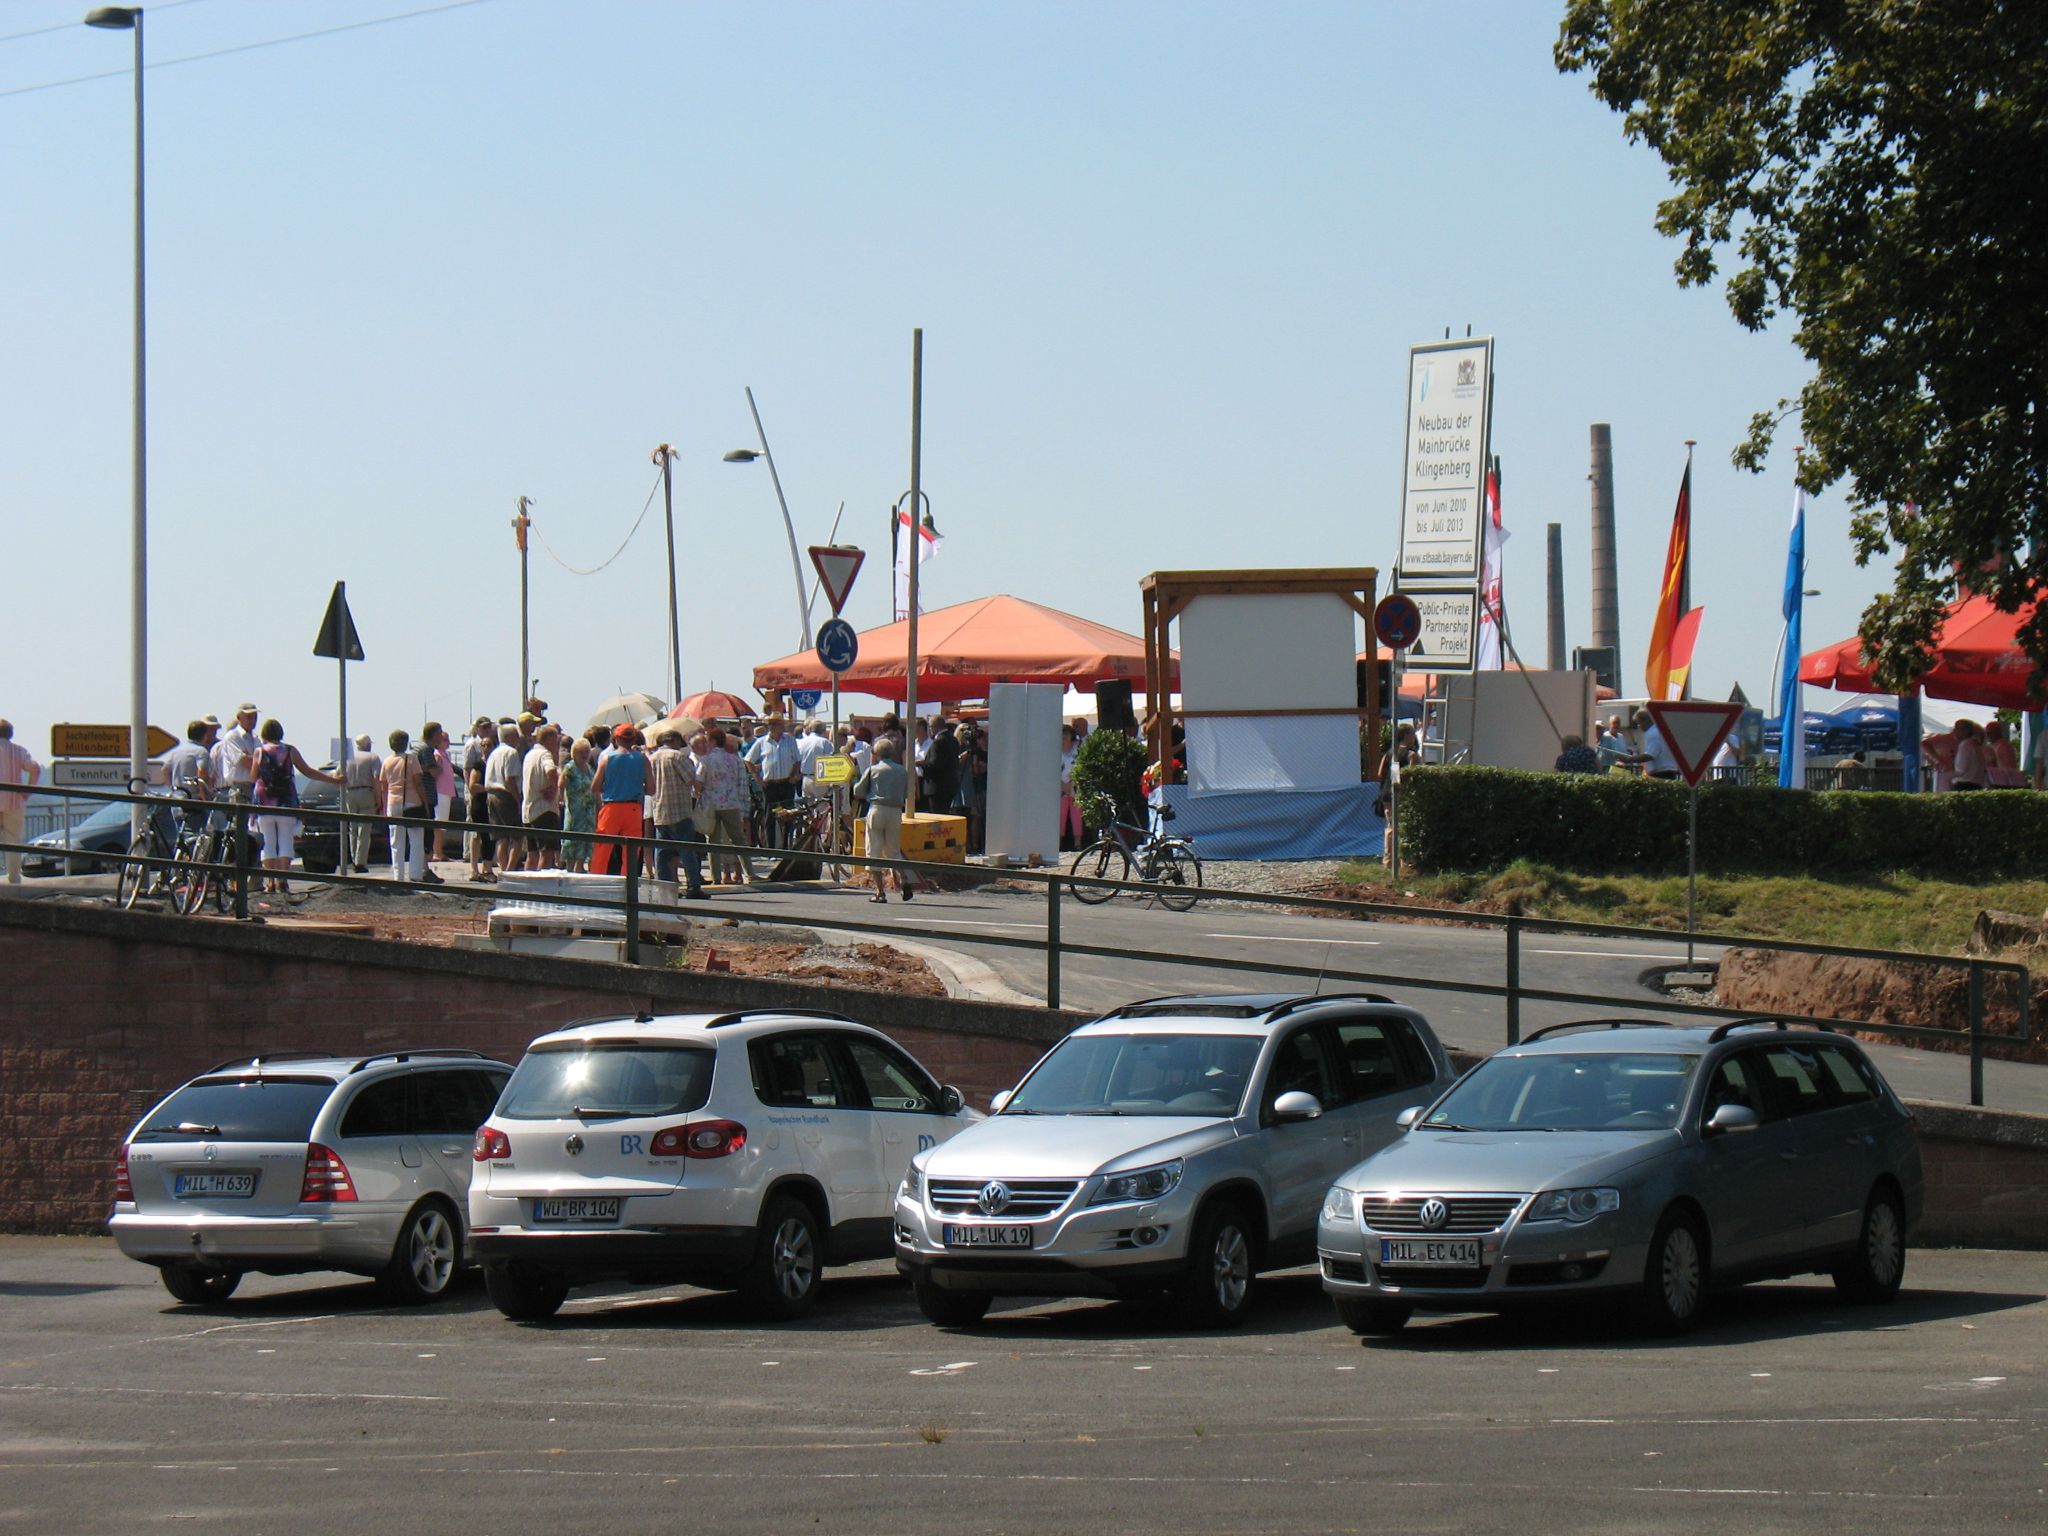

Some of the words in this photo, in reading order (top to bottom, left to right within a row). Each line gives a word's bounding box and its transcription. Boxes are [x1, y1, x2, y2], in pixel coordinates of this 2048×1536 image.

[1418, 414, 1452, 432] Neubau
[1456, 413, 1472, 429] der
[1418, 436, 1470, 454] Mainbrücke
[1415, 460, 1471, 480] Klingenberg
[1416, 502, 1428, 513] von
[1432, 500, 1447, 512] Juni
[1450, 498, 1466, 511] 2010
[1416, 521, 1427, 533] bis
[1430, 519, 1444, 532] Juli
[1447, 518, 1463, 532] 2013
[1418, 601, 1469, 616] Public-Private
[1425, 619, 1468, 634] Partnership
[1440, 637, 1467, 653] Projekt
[65, 743, 120, 753] Miltenberg
[70, 769, 118, 779] Trennfurt
[621, 1135, 643, 1154] BR
[183, 1175, 208, 1191] MIL
[227, 1176, 252, 1191] 639
[590, 1201, 617, 1217] 104
[952, 1226, 979, 1243] MIL
[988, 1227, 1008, 1244] UK
[1011, 1227, 1030, 1244] 19
[1390, 1243, 1416, 1260] MIL
[1427, 1243, 1446, 1260] EC
[1449, 1243, 1477, 1260] 414
